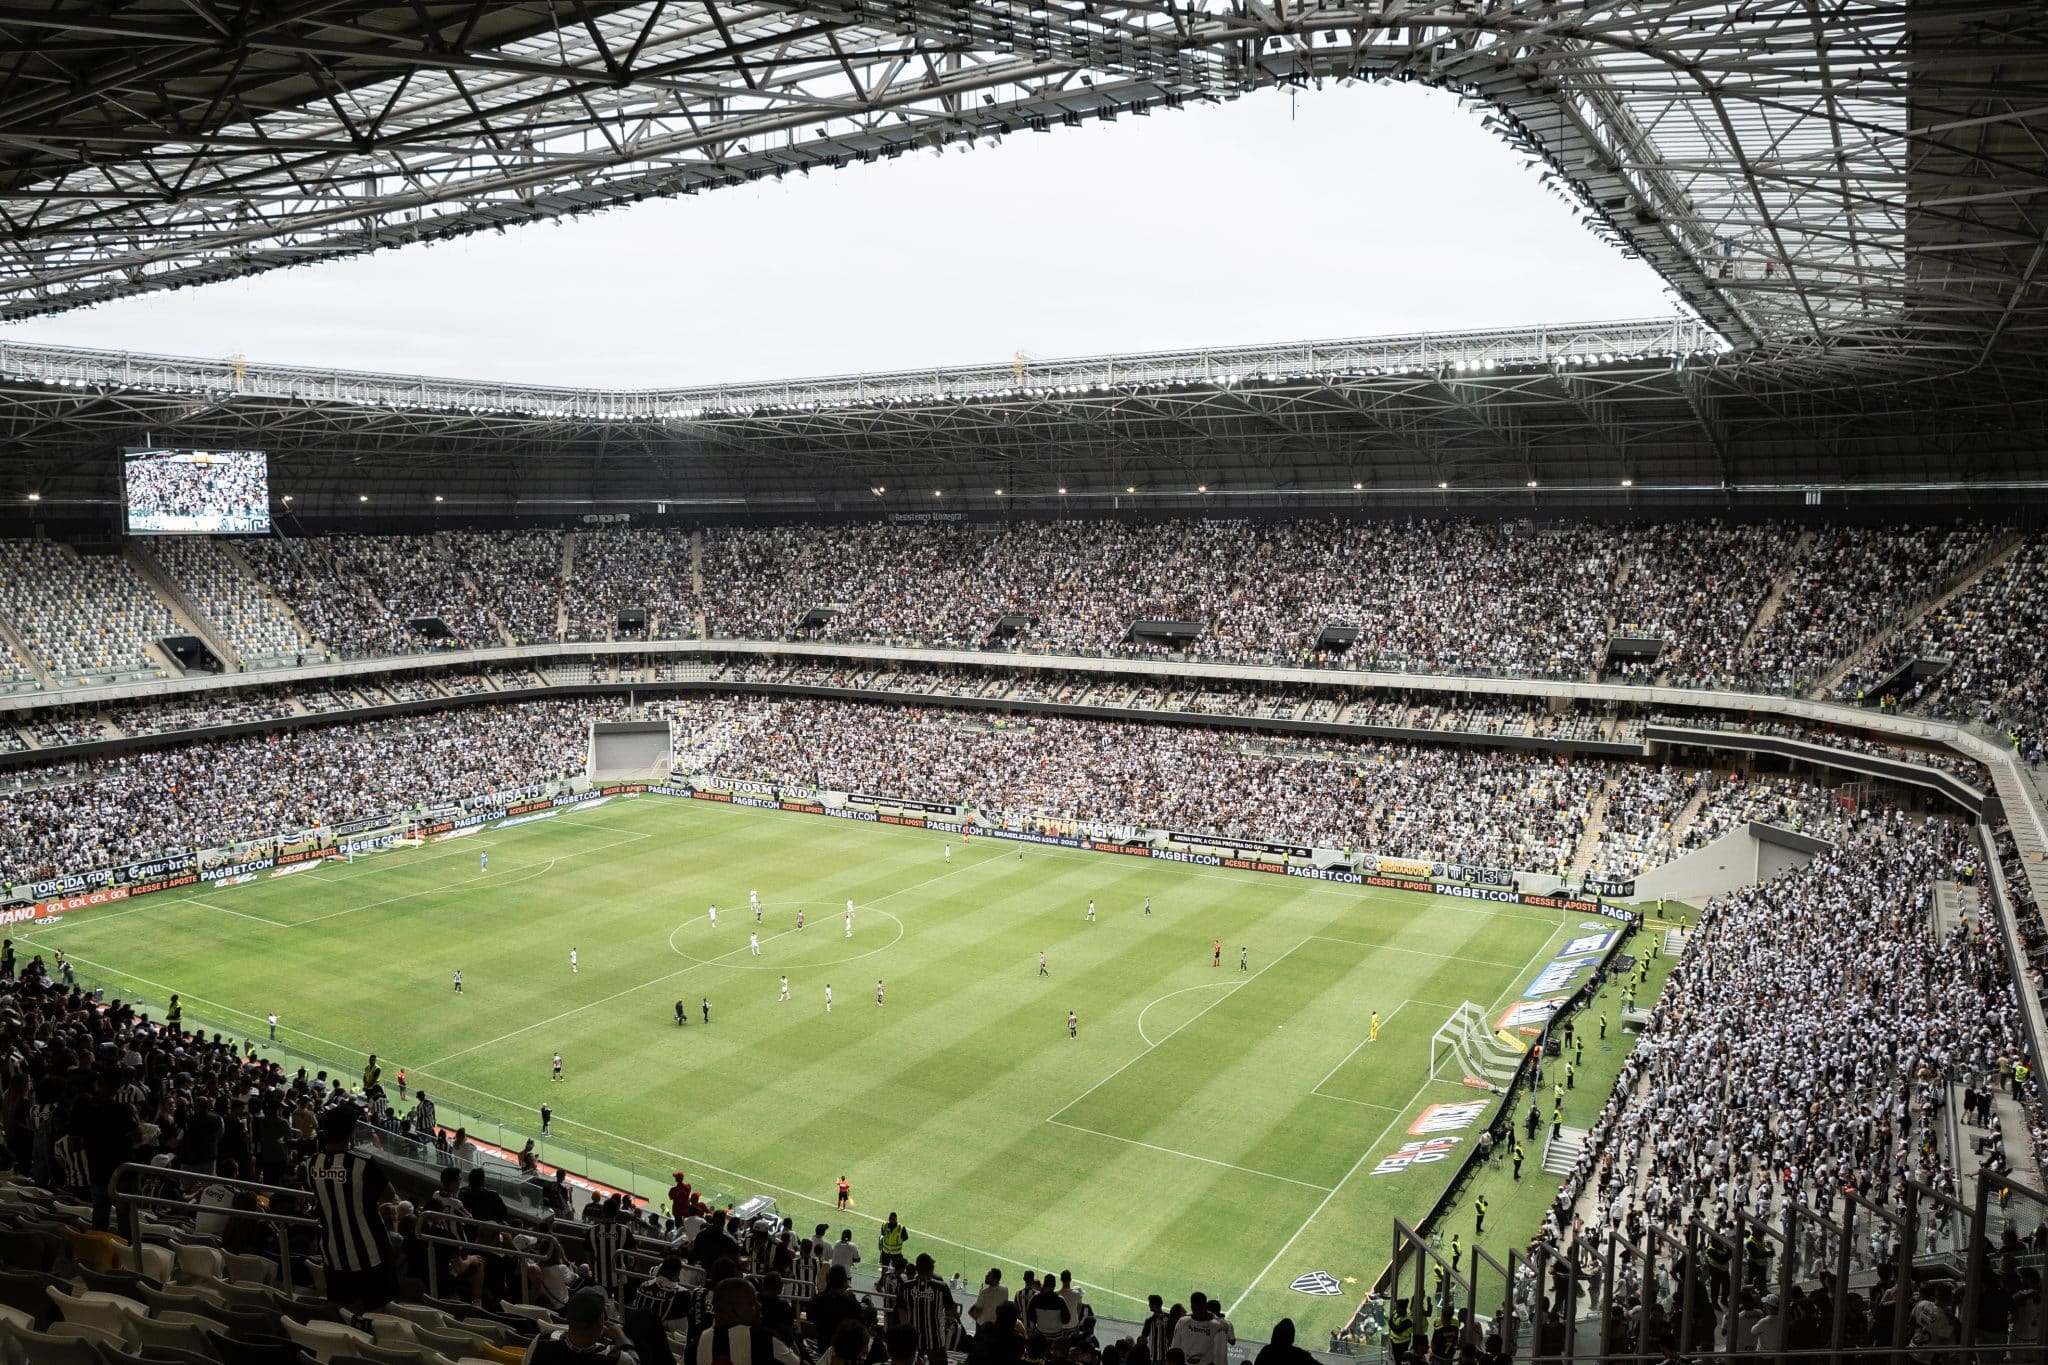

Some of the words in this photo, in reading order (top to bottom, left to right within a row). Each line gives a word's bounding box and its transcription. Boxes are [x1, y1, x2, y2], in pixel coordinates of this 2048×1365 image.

[553, 790, 600, 806] PAGBET.COM
[648, 785, 691, 798] PAGBET.COM
[733, 796, 779, 809] PAGBET.COM
[455, 810, 506, 828] PAGBET.COM
[825, 807, 877, 822] PAGBET.COM
[278, 851, 304, 865] ACESSE
[311, 847, 337, 858] APOSTE
[1096, 843, 1118, 852] ACESSE
[1125, 846, 1150, 856] APOSTE
[1152, 849, 1220, 866] PAGBET.COM
[200, 858, 273, 881] PAGBET.COM
[1224, 859, 1250, 869] ACESSE
[1257, 863, 1285, 873] APOSTE
[1287, 865, 1362, 884] PAGBET.COM
[132, 881, 160, 895] ACESSE
[169, 875, 197, 887] APOSTE
[1367, 878, 1395, 887] ACESSE
[1403, 881, 1432, 892] APOSTE
[1436, 884, 1519, 903] PAGBET.COM
[46, 903, 65, 913] GOL
[68, 897, 87, 908] GOL
[90, 893, 108, 904] GOL
[111, 888, 128, 900] GOL
[1525, 895, 1556, 907] ACESSE
[1565, 901, 1597, 912] APOSTE
[1601, 904, 1635, 921] PAGB
